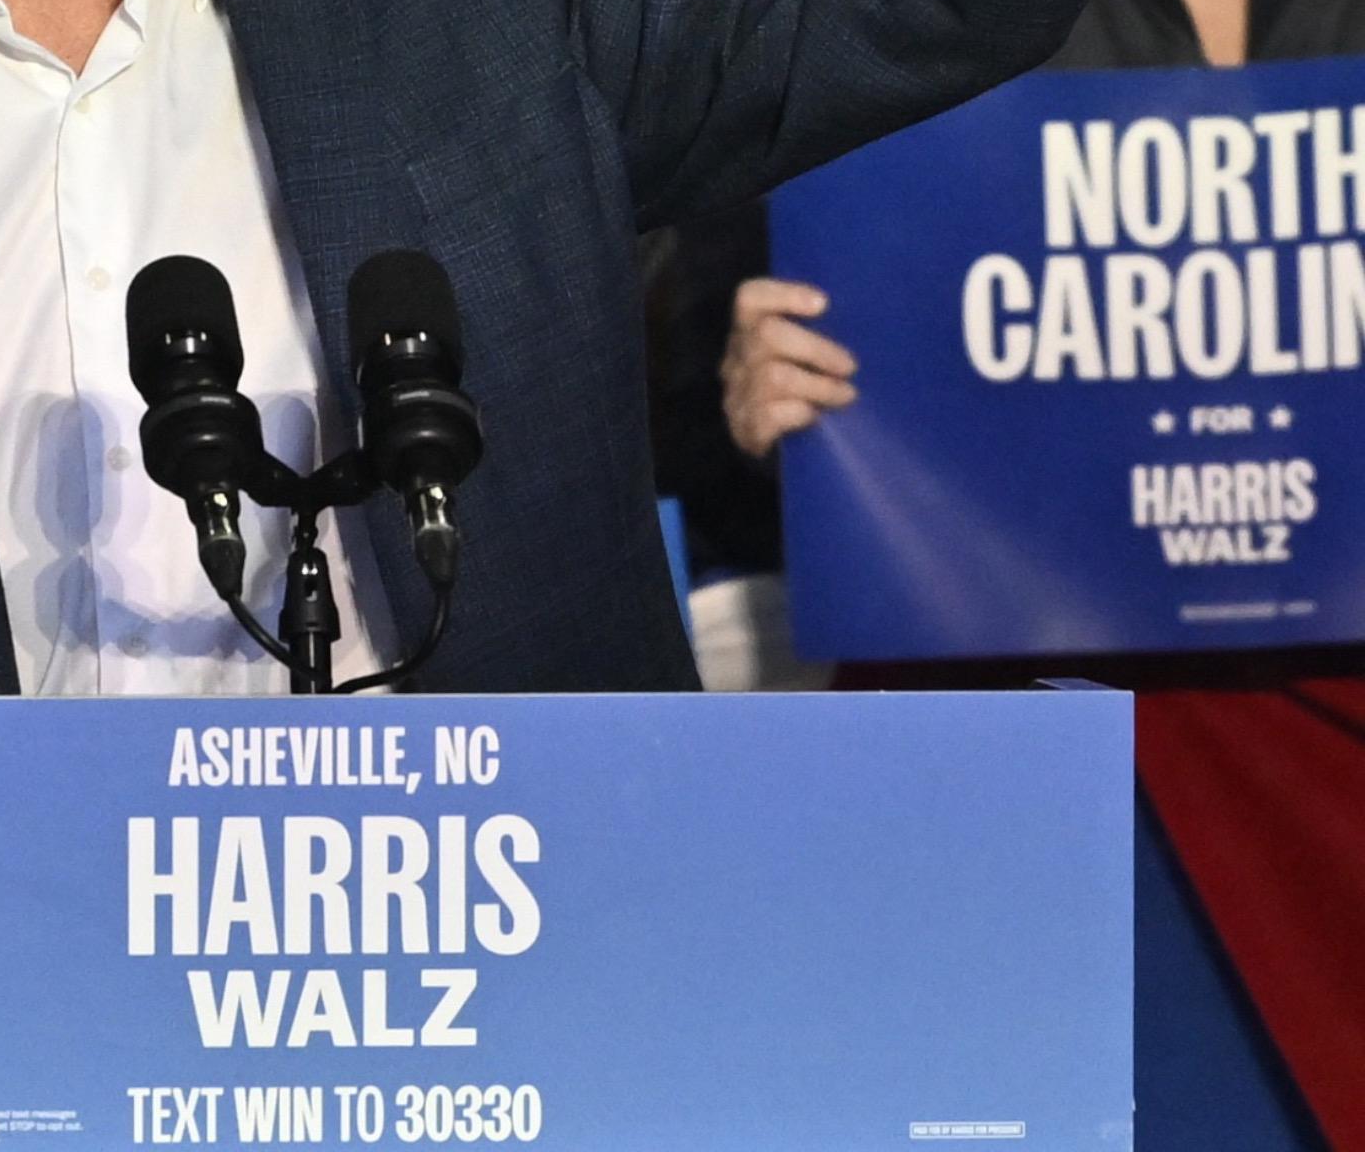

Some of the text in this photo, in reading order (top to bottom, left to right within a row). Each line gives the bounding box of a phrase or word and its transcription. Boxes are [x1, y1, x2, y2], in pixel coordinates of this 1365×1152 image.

[1042, 104, 1365, 249] NORTH
[1189, 405, 1254, 433] FOR
[1131, 457, 1318, 529] HARRIS
[1159, 523, 1293, 565] WALZ
[168, 724, 500, 795] ASHEVILLE, NC
[127, 814, 541, 956] HARRIS
[186, 968, 478, 1048] WALZ
[126, 1084, 543, 1143] TEXT WIN TO 30330
